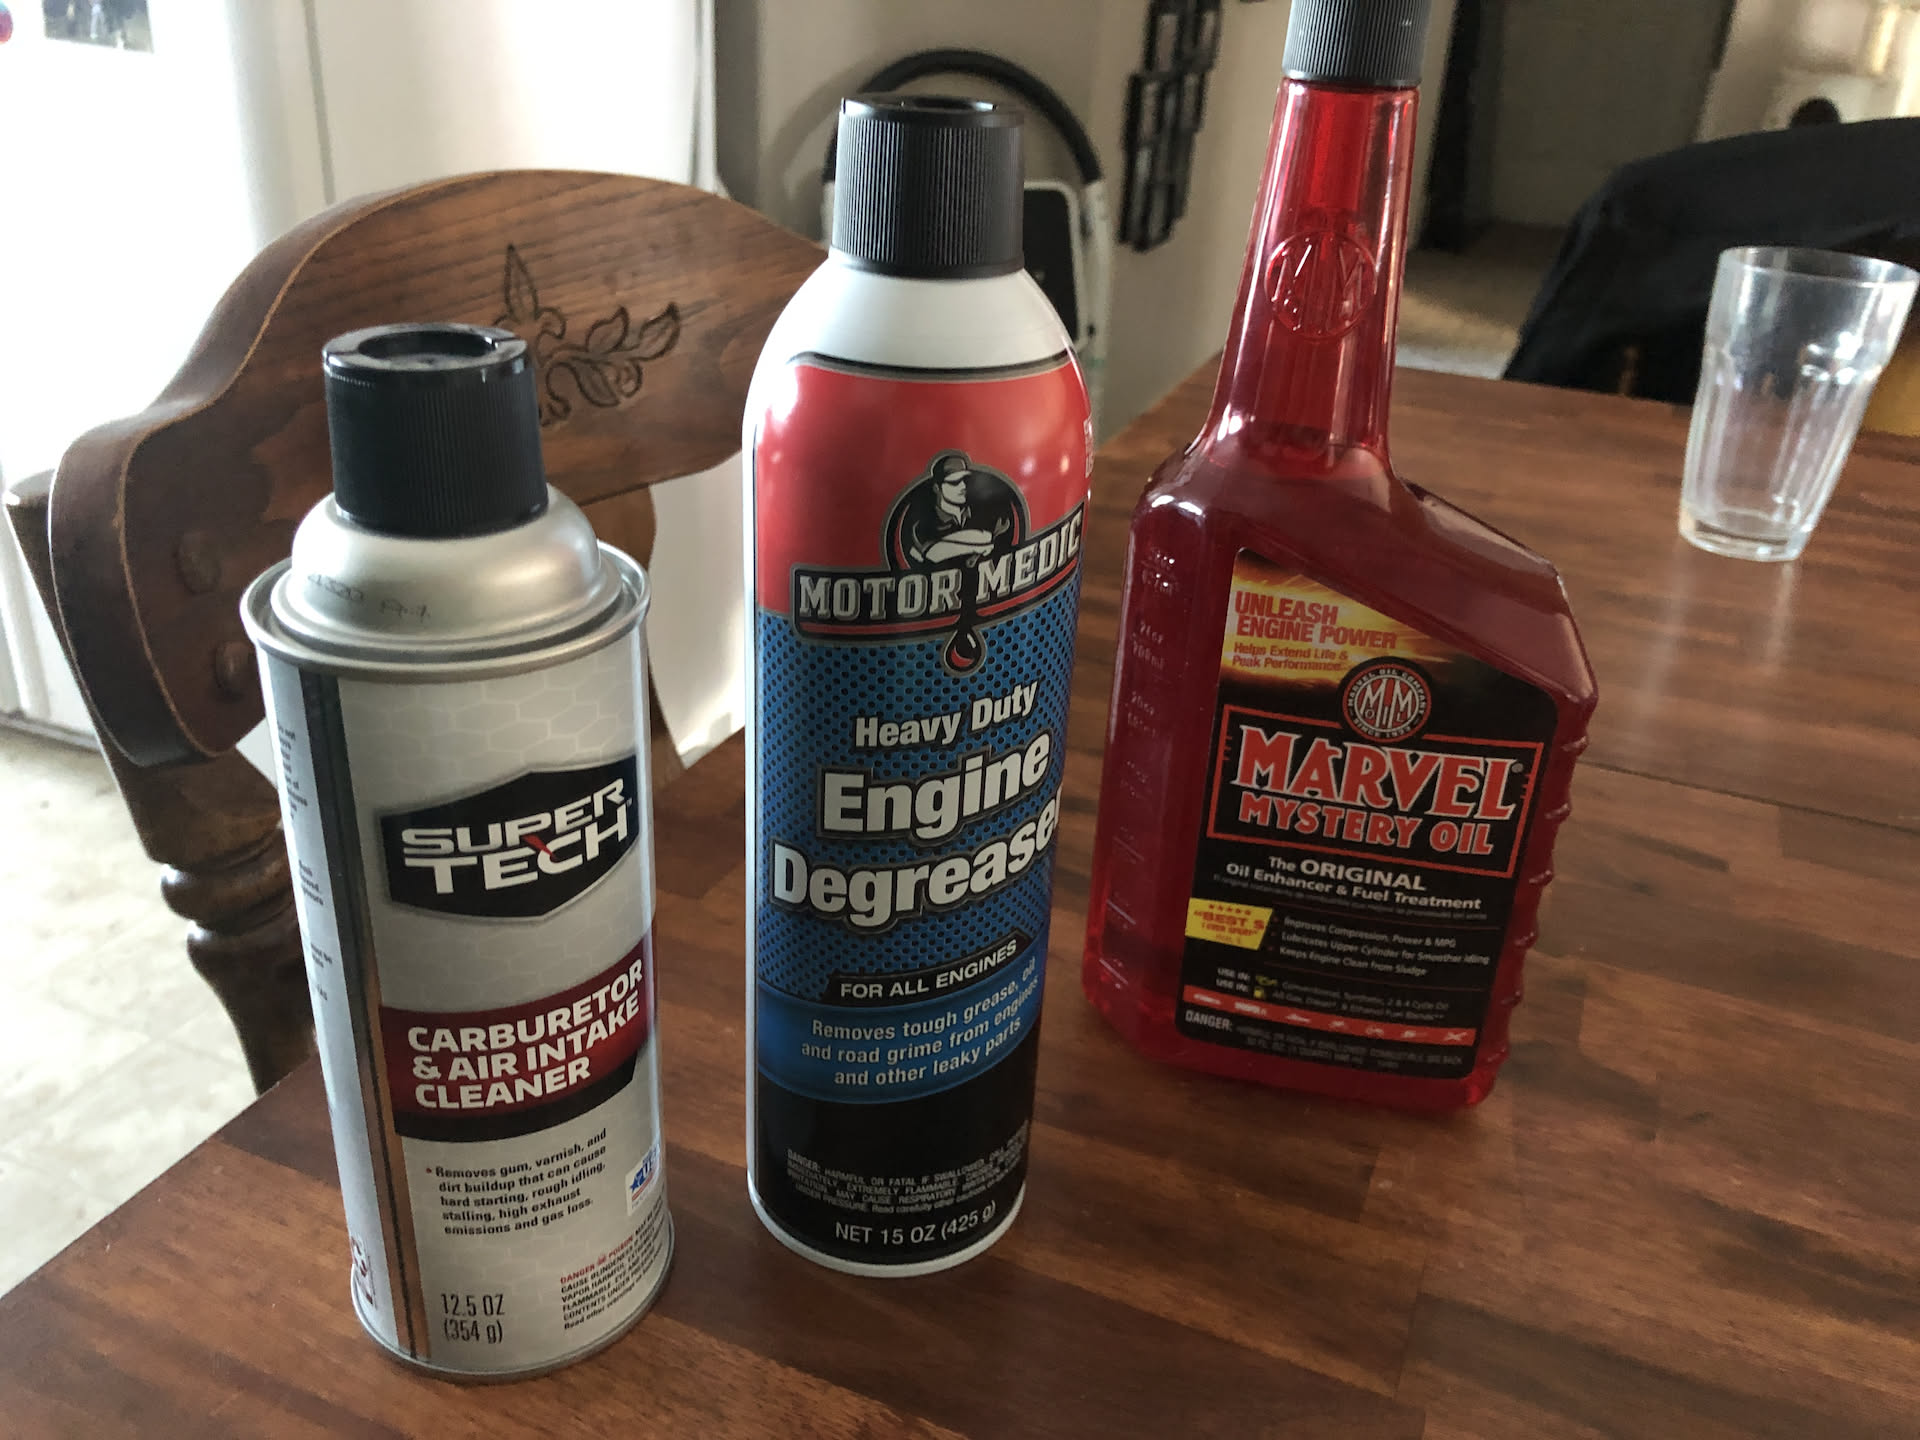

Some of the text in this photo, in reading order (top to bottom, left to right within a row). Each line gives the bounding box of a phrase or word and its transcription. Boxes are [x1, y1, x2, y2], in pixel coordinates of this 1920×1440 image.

[799, 567, 962, 620] MOTOR
[976, 509, 1082, 601] MEDIC
[1235, 591, 1339, 626] UNLEASH
[1234, 642, 1348, 661] Helps Extend Life &
[1237, 615, 1397, 649] ENGINE POWER
[1232, 654, 1260, 668] Peak
[1347, 672, 1376, 707] MARVEL
[1379, 668, 1398, 676] OIL
[855, 681, 1038, 747] Heavy Duty
[823, 733, 1050, 840] Engine
[1230, 724, 1518, 820] MARVEL
[401, 777, 625, 855] SUPER
[1239, 790, 1494, 855] MYSTERY OIL
[404, 802, 628, 894] TECH
[1226, 863, 1482, 910] Oil Enhancer & Fuel Treatment
[1268, 856, 1427, 892] The ORIGINAL
[1284, 915, 1326, 934] Improves
[840, 939, 1018, 999] FOR ALL ENGINES
[407, 959, 643, 1052] CARBURETOR
[812, 1018, 895, 1041] Removes
[903, 1012, 957, 1038] tough
[963, 980, 1019, 1018] grease,
[412, 990, 640, 1081] & AIR INTAKE
[801, 1041, 831, 1060] and
[837, 1047, 880, 1064] road
[887, 1039, 942, 1065] grime
[949, 1022, 989, 1049] from
[834, 1017, 1021, 1086] and other leaky parts
[415, 1056, 591, 1109] CLEANER
[435, 1128, 607, 1179] Removes gum, varnish, and
[439, 1145, 607, 1193] dirt buildup that can cause
[440, 1195, 470, 1207] hard
[473, 1193, 529, 1207] starting,
[532, 1179, 568, 1199] rough
[889, 1177, 917, 1186] FATAL
[442, 1187, 581, 1223] stalling, high exhaust
[444, 1197, 593, 1236] emissions and gas loss.
[835, 1200, 996, 1244] NET 15 OZ (425 g)
[441, 1293, 505, 1316] 12.5 OZ
[561, 1277, 588, 1294] CAUSE
[561, 1286, 589, 1303] VAPOR
[444, 1320, 504, 1345] (354 g)
